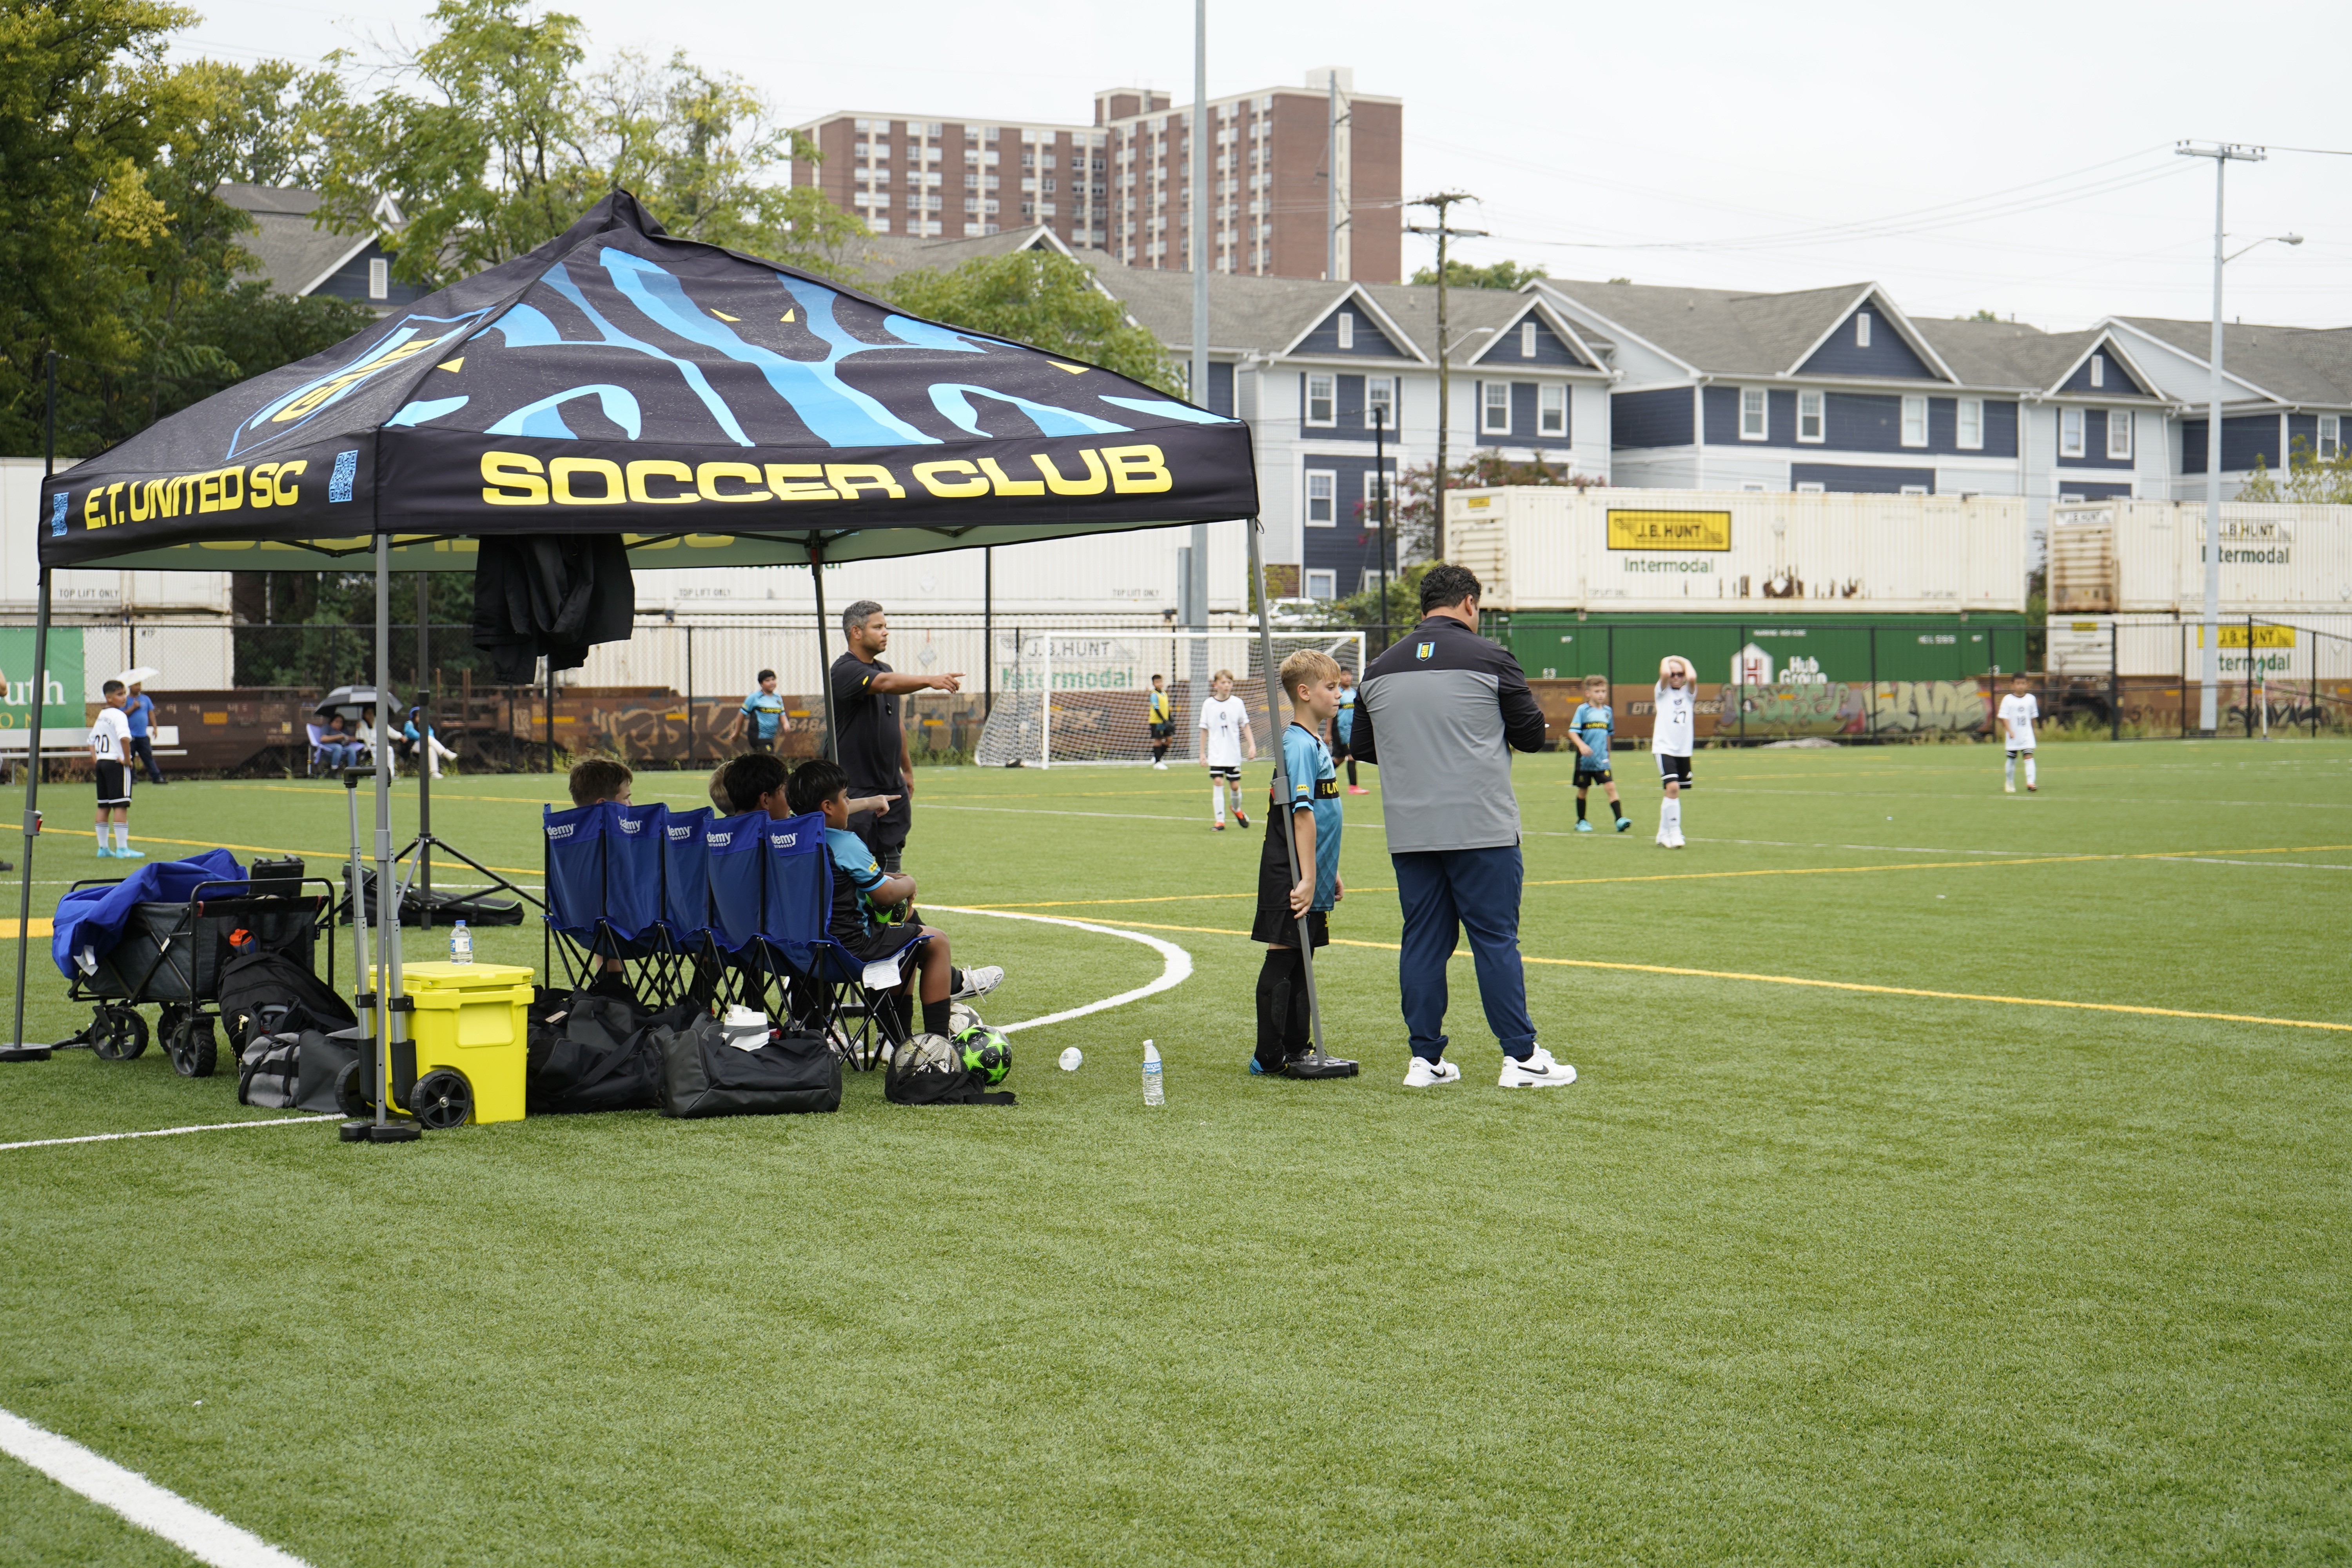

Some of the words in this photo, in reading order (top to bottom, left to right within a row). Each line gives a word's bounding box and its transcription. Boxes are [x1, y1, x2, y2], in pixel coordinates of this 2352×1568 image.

[481, 451, 906, 505] SOCCER
[912, 445, 1172, 497] CLUB
[84, 481, 125, 530] E.T.
[130, 465, 246, 522] UNITED
[250, 459, 308, 508] SC
[1664, 524, 1701, 538] HUNT
[2242, 524, 2274, 536] HUNT
[2201, 545, 2289, 563] Itermodal
[1624, 557, 1714, 572] Intermodal
[60, 588, 75, 599] TOP
[78, 588, 96, 598] LIFT
[99, 589, 119, 598] ONLY
[1062, 642, 1111, 656] HUNT
[1789, 656, 1819, 673] Hub
[1673, 710, 1686, 724] 27
[706, 831, 731, 845] demy
